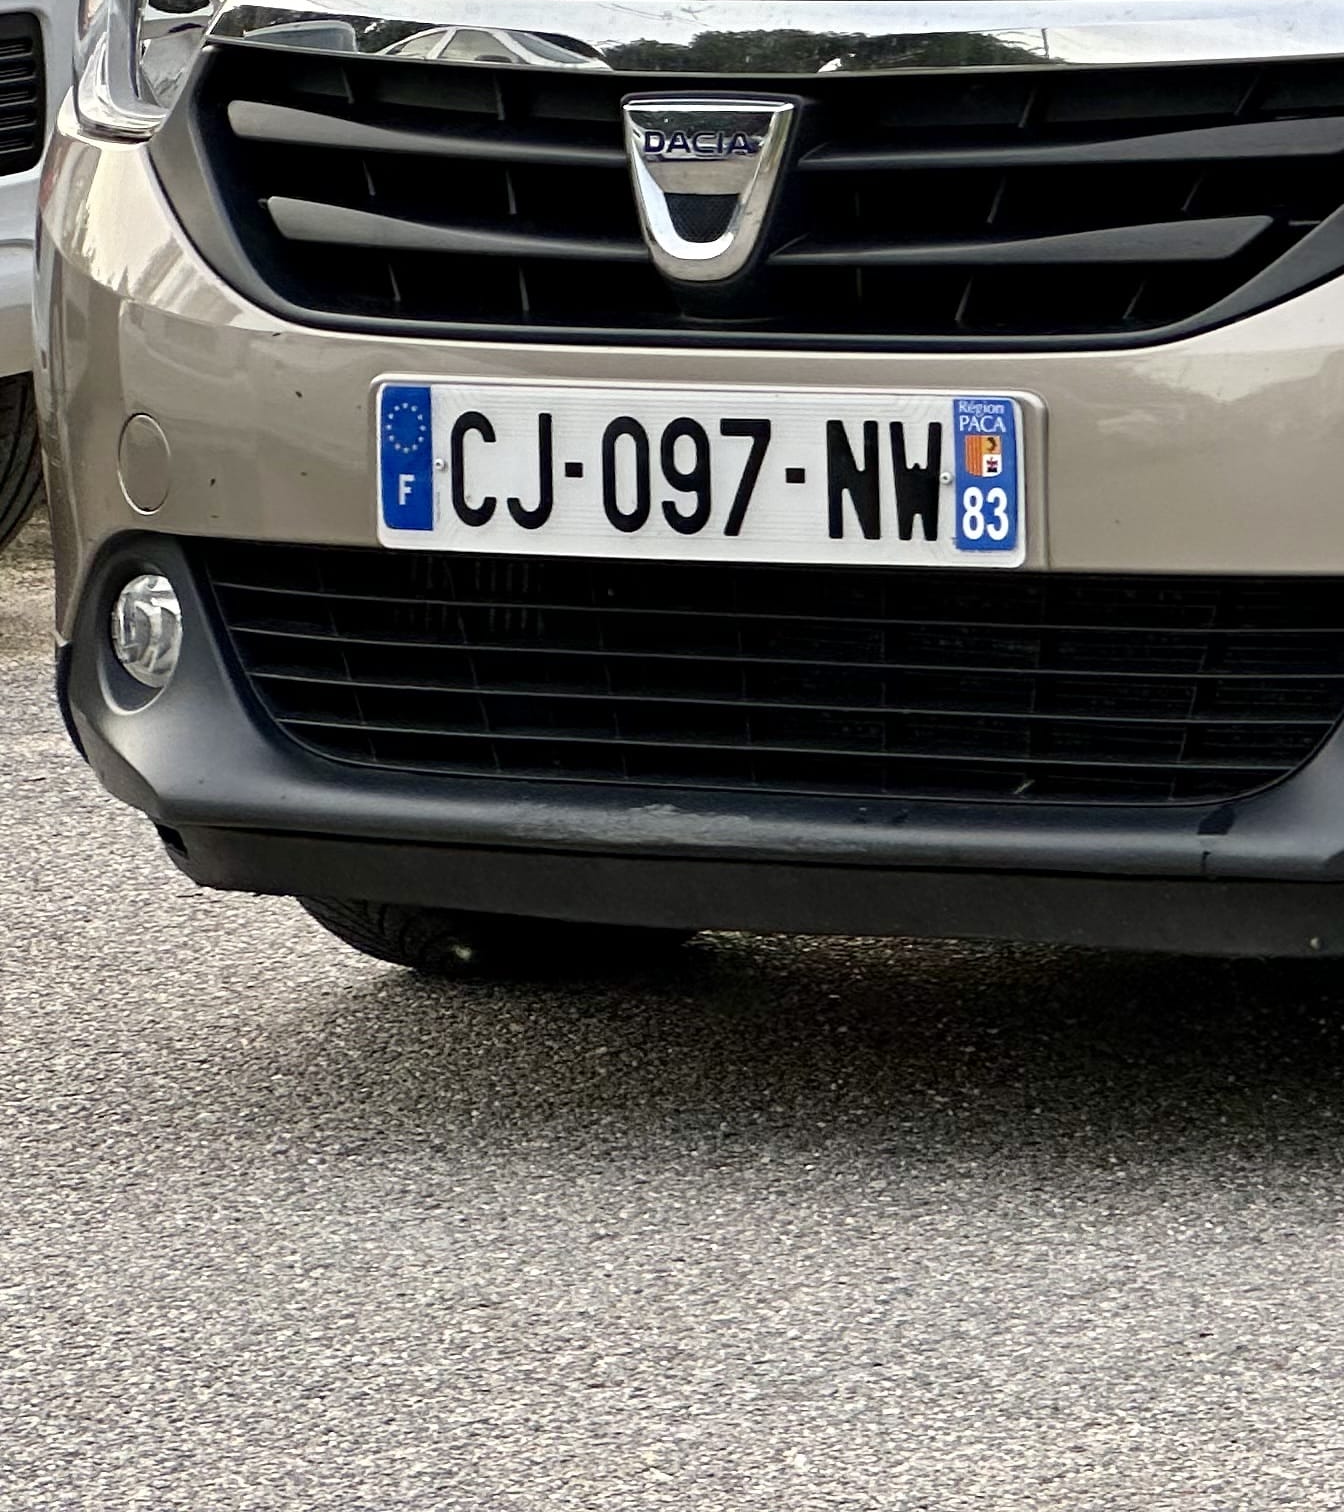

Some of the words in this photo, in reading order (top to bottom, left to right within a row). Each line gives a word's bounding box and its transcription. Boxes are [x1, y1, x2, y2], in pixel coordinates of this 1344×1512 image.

[644, 130, 757, 156] DACIA
[958, 400, 1005, 417] Région
[958, 415, 1006, 433] PACA
[398, 473, 416, 506] F
[450, 410, 943, 542] CJ-097-NW
[962, 486, 1009, 541] 83
